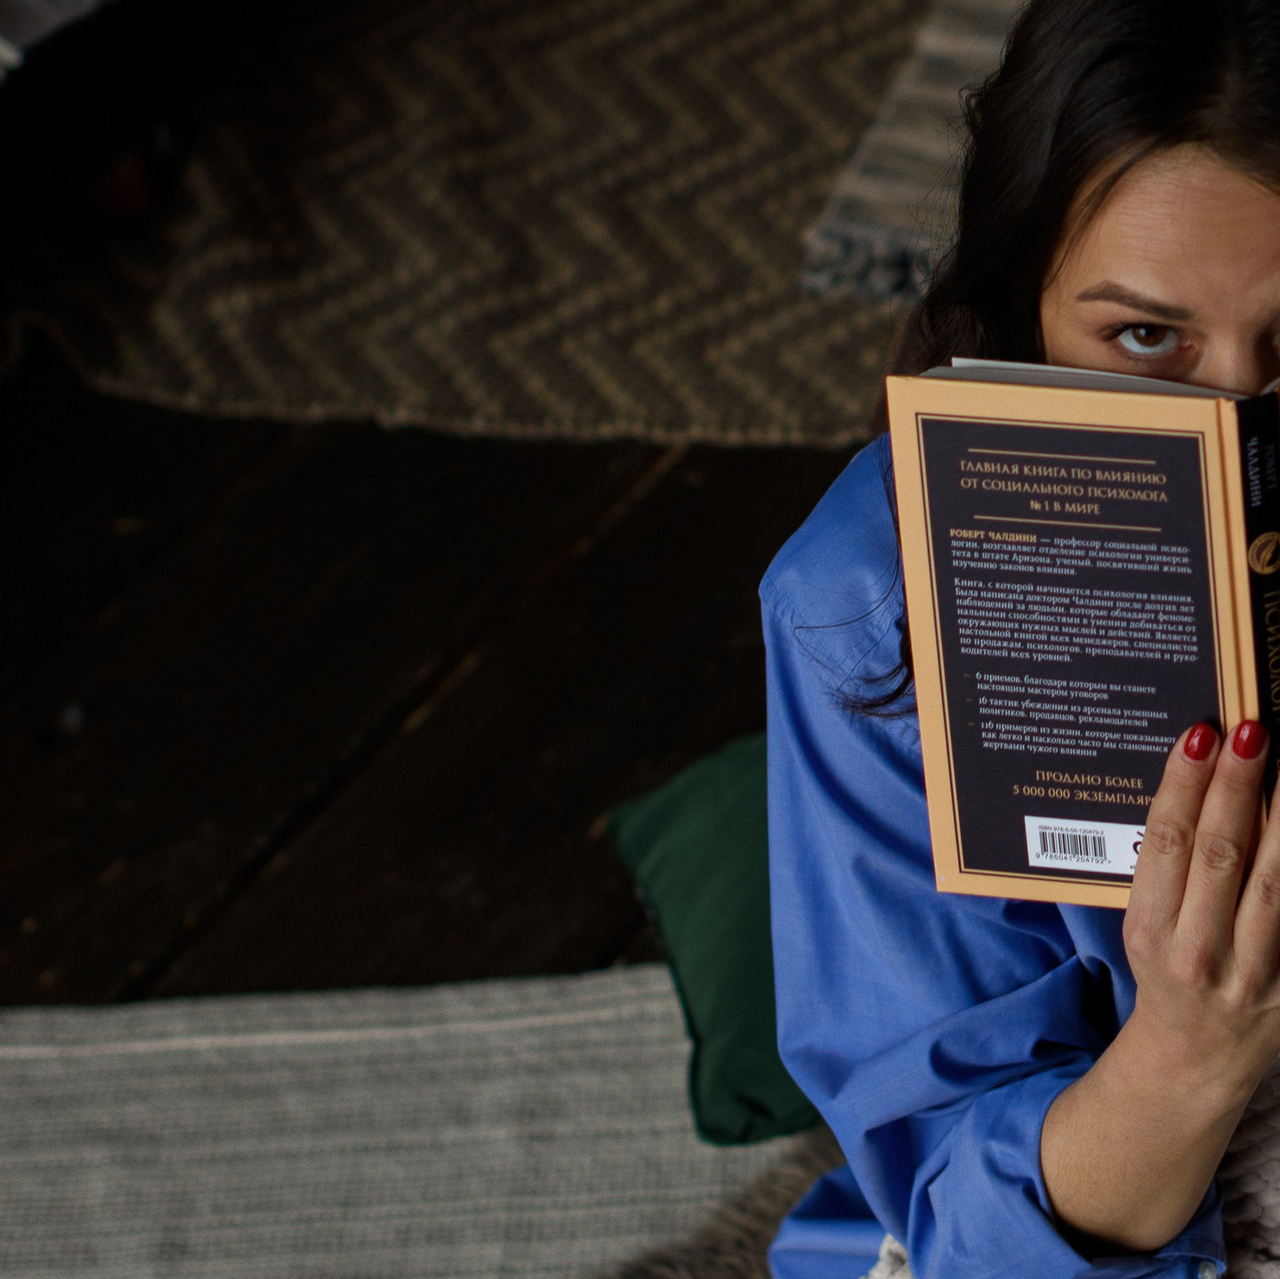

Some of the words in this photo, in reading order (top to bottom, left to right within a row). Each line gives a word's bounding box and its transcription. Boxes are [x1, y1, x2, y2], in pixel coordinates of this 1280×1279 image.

[959, 460, 1019, 475] ГЛАВНАЯ
[1022, 464, 1067, 478] КНИГА
[1070, 467, 1092, 480] ПО
[1094, 469, 1167, 485] ВЛИЯНИЮ
[1246, 436, 1262, 508] ЧАЛДИНИ
[959, 477, 979, 489] ОТ
[981, 478, 1084, 497] СОЦИАЛЬНОГО
[1087, 486, 1167, 502] ПСИХОЛОГА
[1064, 502, 1101, 514] МИРЕ
[948, 528, 985, 539] РОБЕРТ
[987, 530, 1037, 543] ЧАЛДИНИ
[1053, 534, 1101, 550] профессор
[1103, 539, 1157, 553] социальной
[1160, 545, 1189, 554] психо-
[951, 549, 971, 558] тета
[981, 552, 1009, 561] штате
[1095, 558, 1159, 571] посвятивший
[1162, 565, 1192, 574] жизнь
[952, 559, 997, 572] изучению
[999, 563, 1034, 572] законов
[982, 542, 1036, 553] возглавляет
[1038, 546, 1086, 558] отделение
[1088, 550, 1142, 560] психологии
[1144, 554, 1190, 566] универси-
[954, 586, 978, 597] Была
[980, 590, 1023, 600] написана
[1025, 594, 1070, 606] доктором
[1071, 595, 1113, 608] Чалдини
[1115, 600, 1142, 609] после
[1144, 602, 1177, 613] долгих
[1179, 605, 1194, 613] лет
[994, 580, 1034, 594] которой
[1035, 585, 1090, 596] начинается
[1092, 589, 1148, 600] психология
[955, 595, 1013, 611] наблюдений
[1069, 607, 1108, 619] которые
[1109, 607, 1155, 621] обладают
[1156, 610, 1195, 625] феноме-
[956, 608, 1006, 618] нальными
[1007, 609, 1080, 624] способностями
[1089, 618, 1127, 630] умении
[1128, 618, 1183, 633] добиваться
[1184, 625, 1196, 633] от
[957, 618, 1019, 631] окружающих
[1021, 622, 1060, 634] нужных
[1061, 623, 1096, 635] мыслей
[1154, 630, 1197, 642] Является
[958, 625, 1011, 638] настольной
[1013, 629, 1047, 641] книгой
[1050, 634, 1069, 642] всех
[1133, 640, 1198, 654] специалистов
[960, 644, 1008, 658] водителей
[1010, 650, 1030, 659] всех
[1084, 644, 1161, 661] преподавателей
[1172, 653, 1198, 664] руко-
[976, 682, 1025, 694] настоящим
[1027, 686, 1068, 699] мастером
[1069, 690, 1108, 702] уговоров
[1023, 674, 1067, 689] благодаря
[1068, 680, 1107, 692] которым
[1109, 683, 1121, 691] вы
[1122, 684, 1156, 694] станете
[978, 695, 987, 705] 16
[988, 698, 1018, 707] тактик
[1020, 698, 1068, 713] убеждения
[1070, 704, 1081, 712] из
[1082, 705, 1121, 718] арсенала
[1123, 708, 1168, 721] успешных
[980, 719, 994, 729] 116
[994, 723, 1038, 735] примеров
[1039, 726, 1050, 734] из
[1084, 730, 1122, 742] которые
[1078, 712, 1148, 729] рекламодателей
[981, 731, 997, 739] как
[998, 732, 1022, 741] легко
[1032, 735, 1076, 745] насколько
[1077, 739, 1101, 747] часто
[1102, 741, 1116, 749] мы
[1117, 742, 1168, 753] становимся
[982, 741, 1025, 753] жертвами
[1027, 744, 1058, 756] чужого
[1060, 747, 1096, 756] влияния
[1035, 770, 1101, 785] ПРОДАНО
[1104, 776, 1143, 789] БОЛЕЕ
[1021, 785, 1045, 797] 000
[1047, 787, 1070, 799] 000
